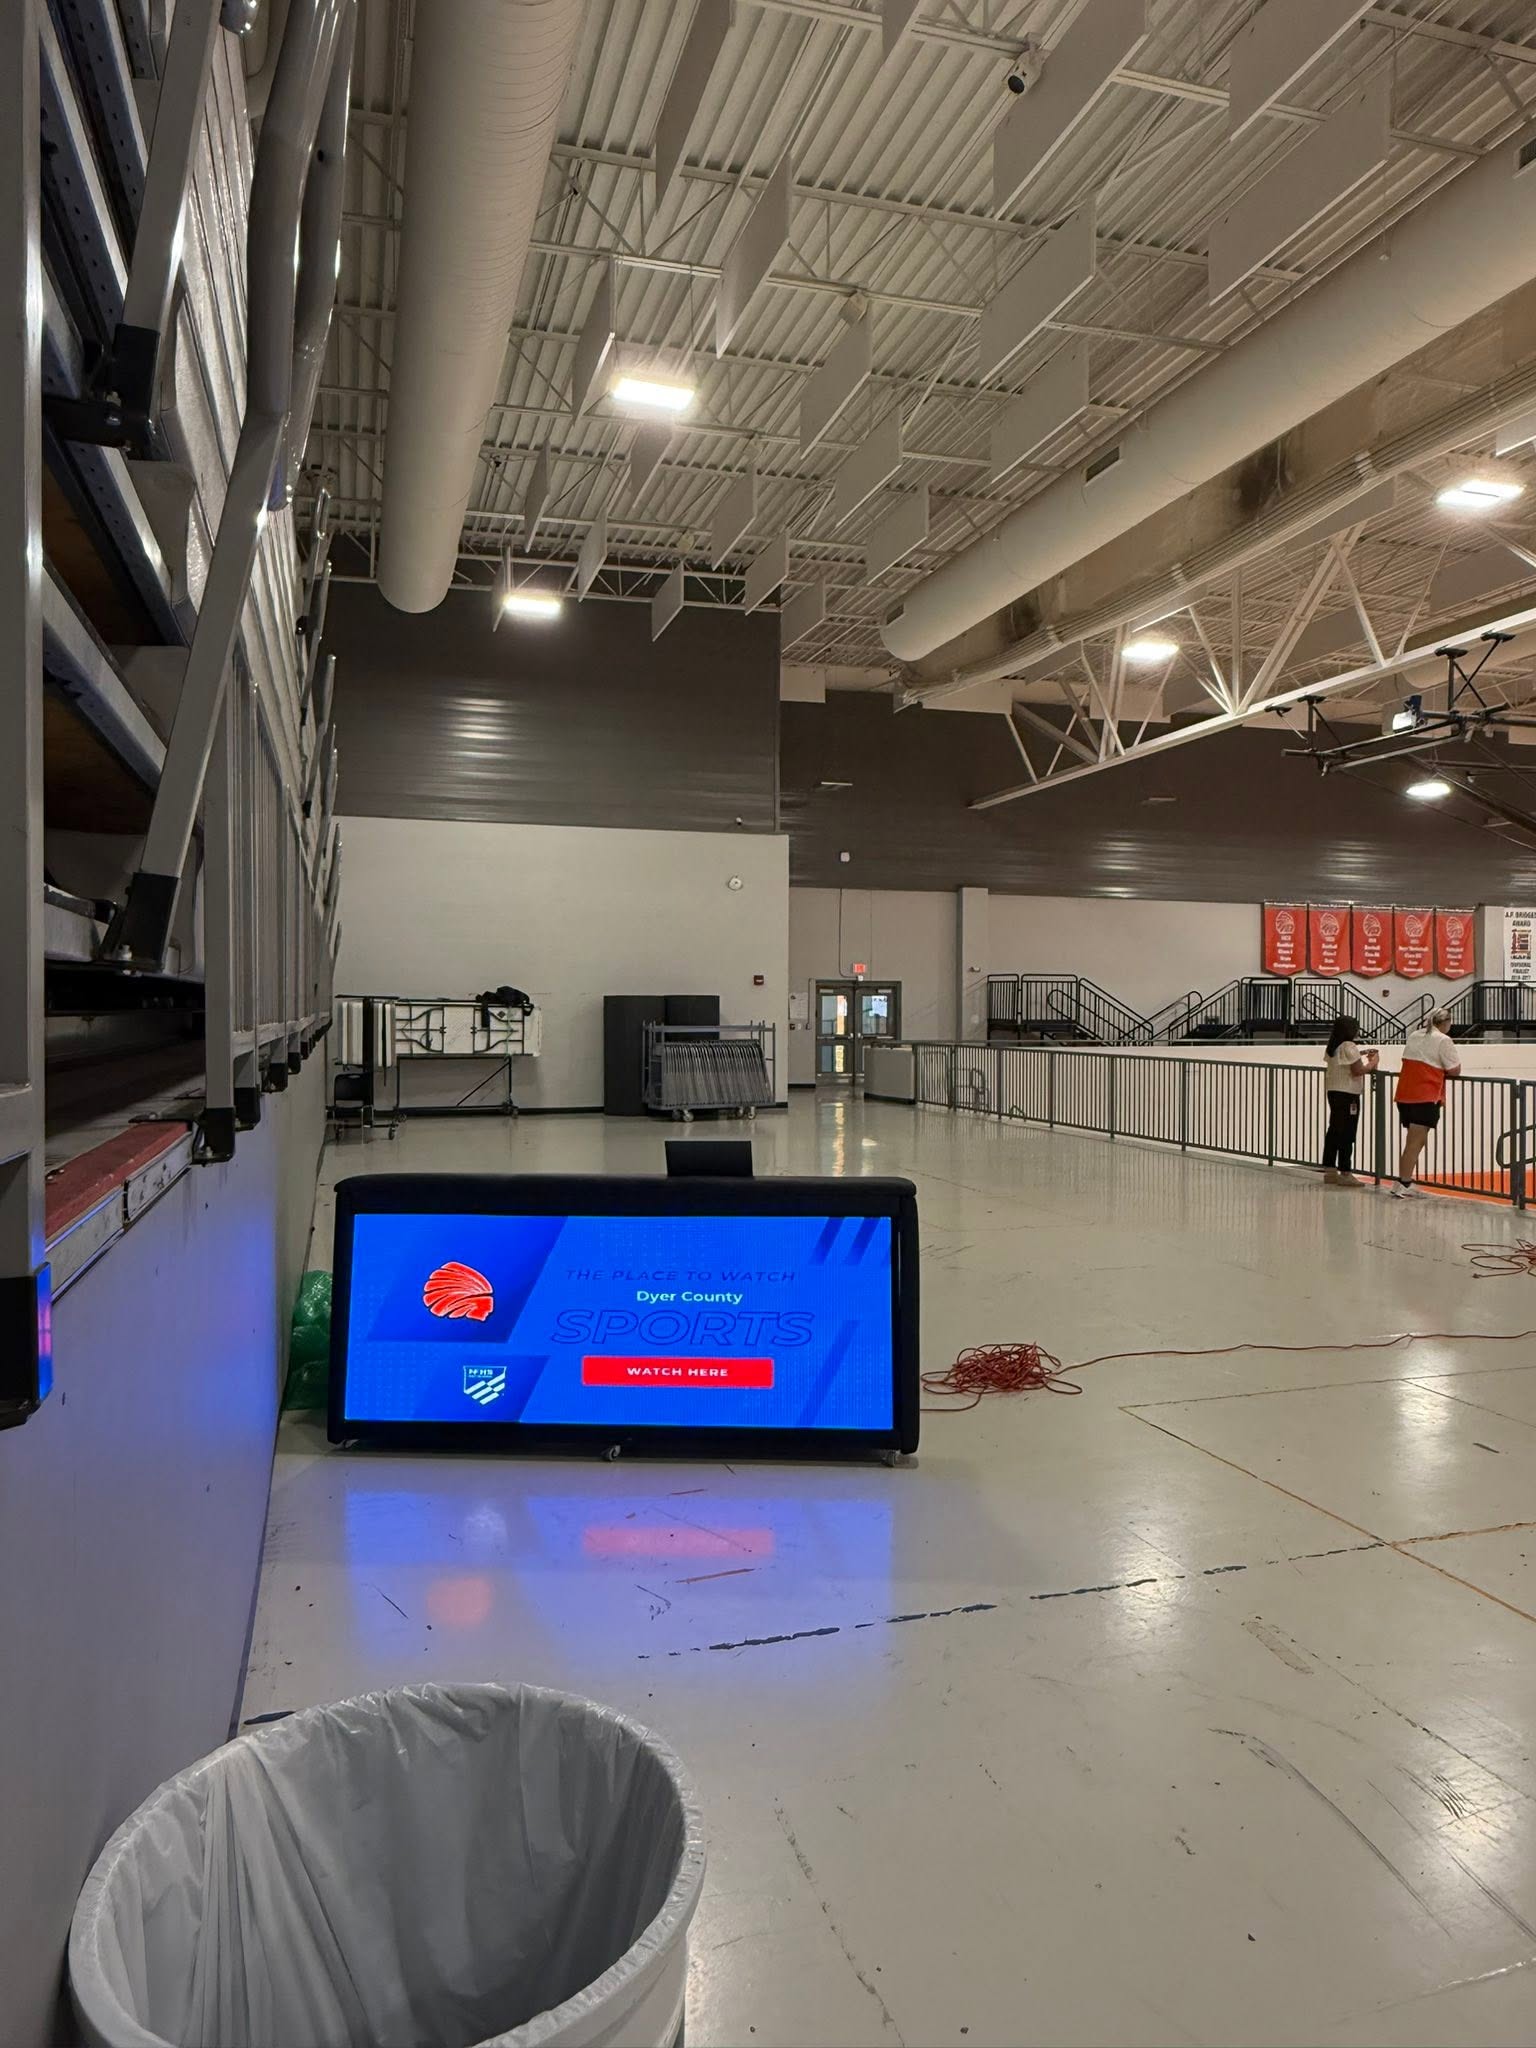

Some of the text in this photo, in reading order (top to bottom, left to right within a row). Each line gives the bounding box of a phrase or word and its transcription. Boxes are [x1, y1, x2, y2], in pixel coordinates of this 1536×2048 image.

[567, 1269, 796, 1282] THE PLACE TO WATCH
[636, 1290, 743, 1305] Dyer County
[551, 1309, 816, 1347] SPORTS
[627, 1366, 729, 1377] WATCH HERE
